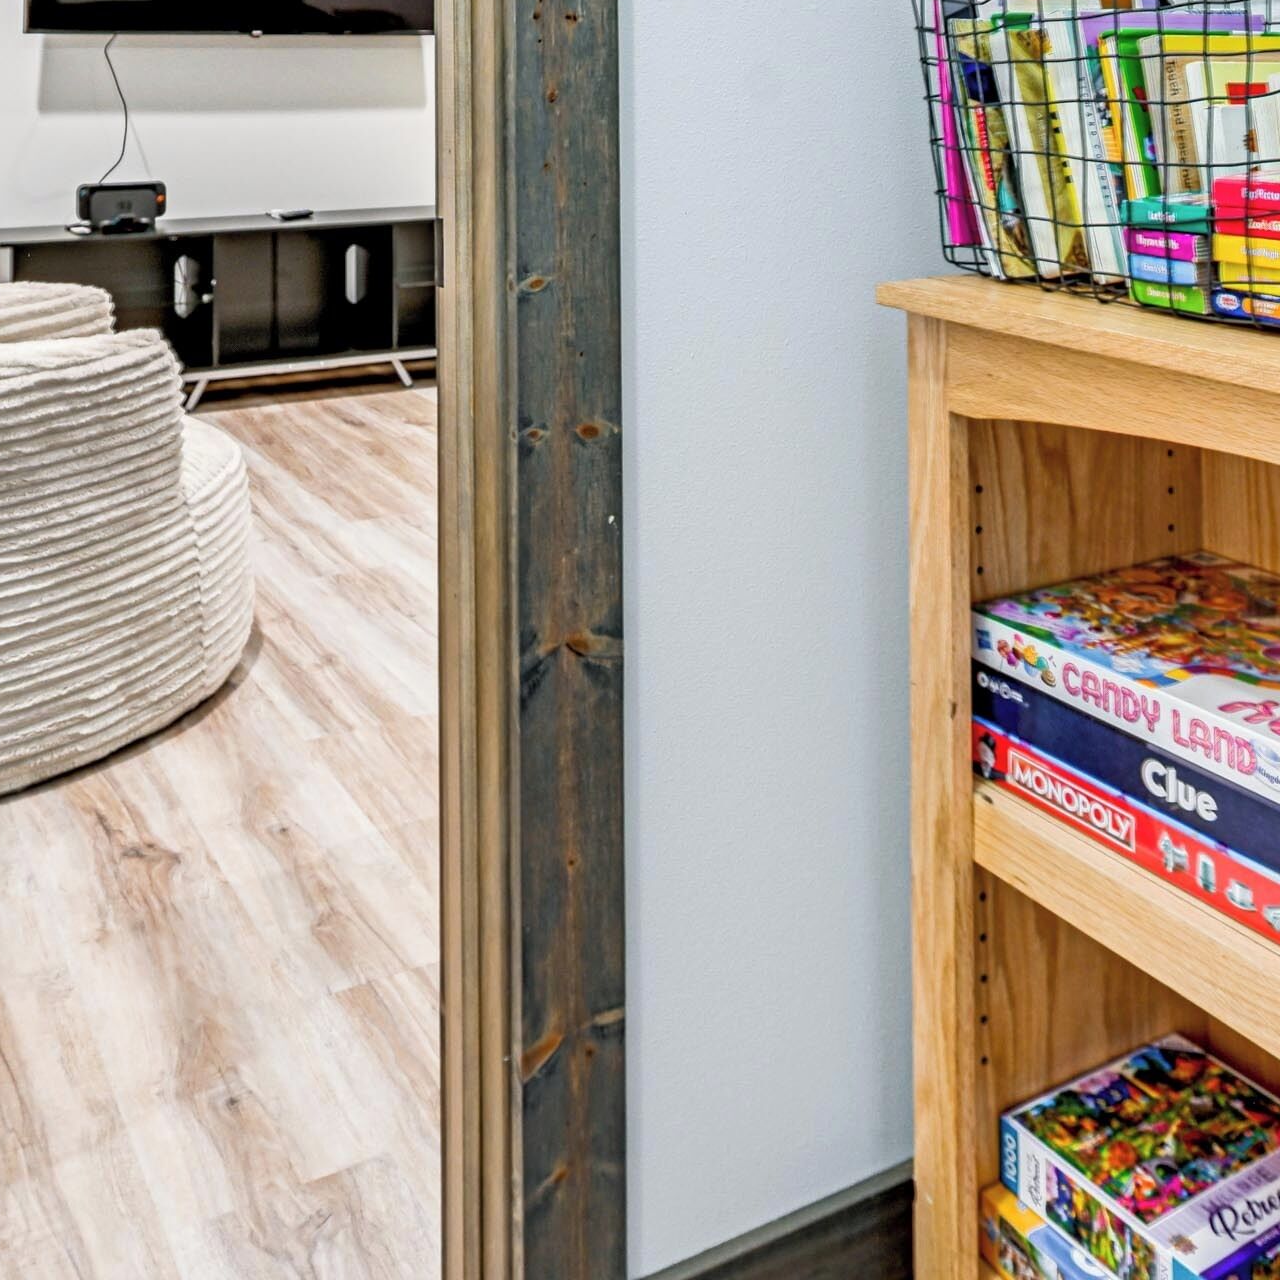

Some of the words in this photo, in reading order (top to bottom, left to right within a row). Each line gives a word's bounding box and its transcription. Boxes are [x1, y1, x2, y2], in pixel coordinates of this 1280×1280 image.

[1062, 662, 1160, 732] CANDY
[1172, 709, 1257, 776] LAND
[1012, 761, 1133, 841] MONOPOLY
[1141, 758, 1218, 822] Clue
[1004, 1135, 1018, 1182] 1000
